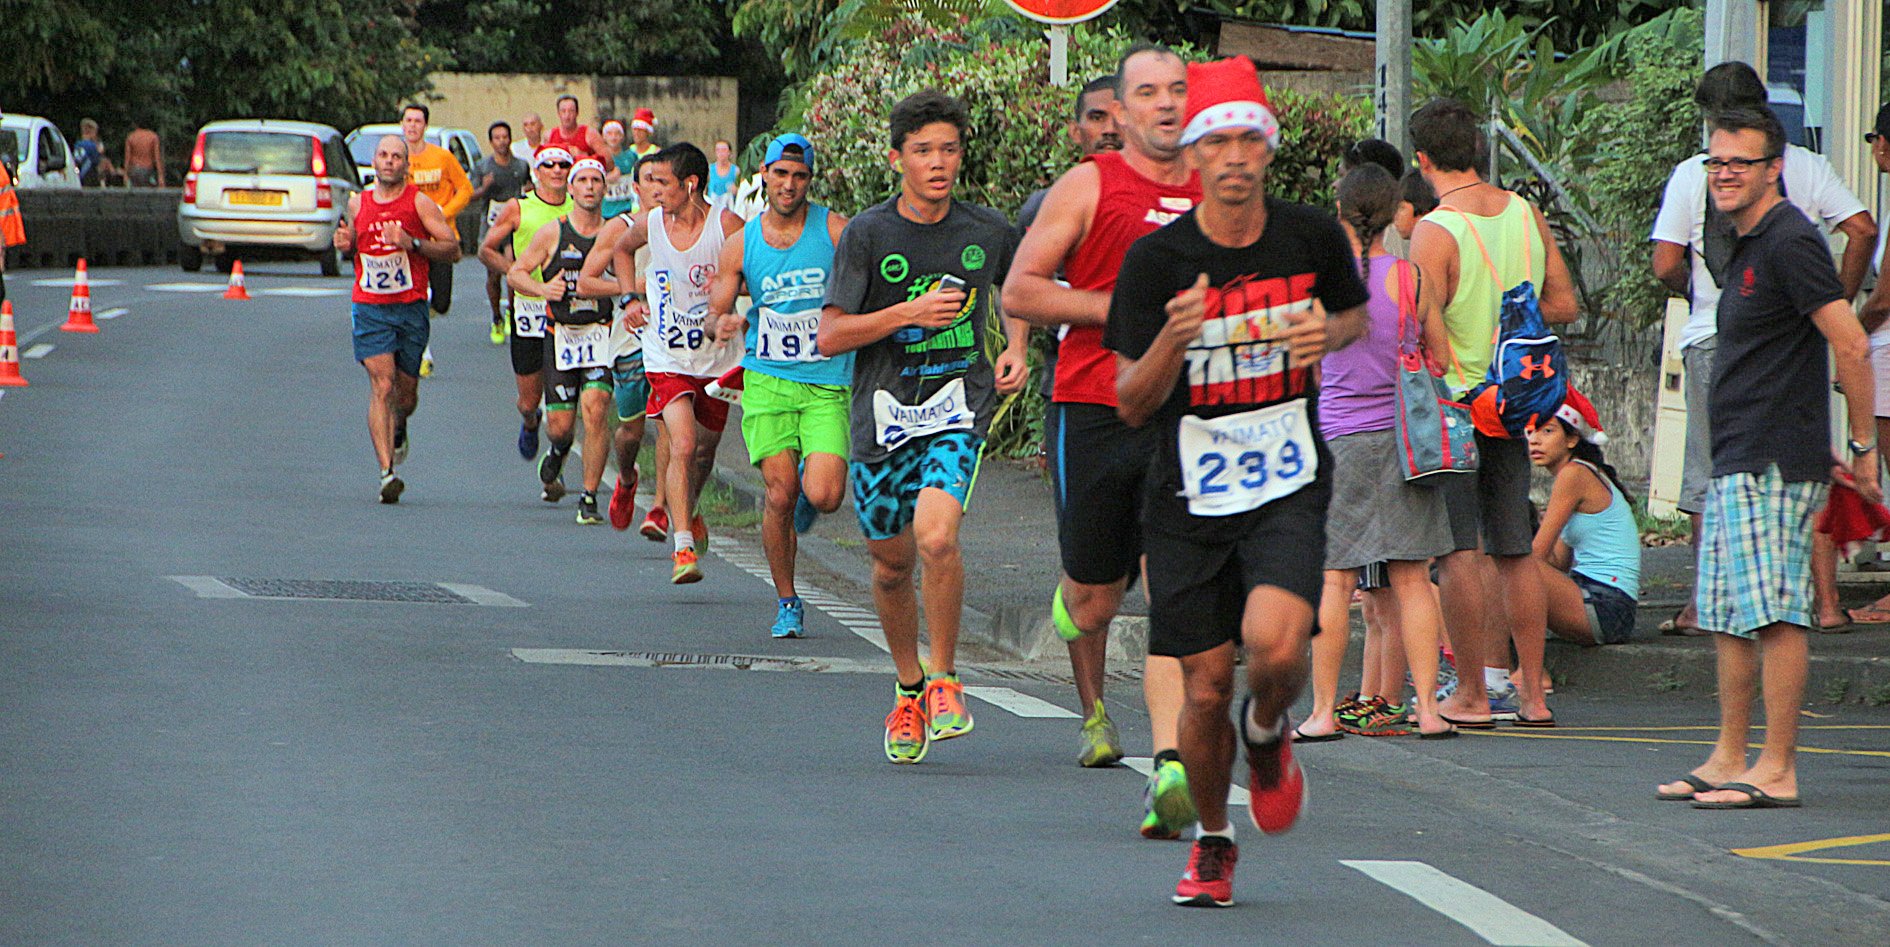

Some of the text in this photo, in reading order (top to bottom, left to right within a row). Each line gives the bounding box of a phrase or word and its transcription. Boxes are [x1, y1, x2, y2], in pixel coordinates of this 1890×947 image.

[366, 268, 407, 289] 124
[761, 268, 826, 292] AITO
[761, 284, 825, 304] SPORT
[1175, 271, 1316, 347] RIDE
[766, 316, 819, 332] VAIMATO
[561, 344, 595, 365] 411
[888, 396, 955, 423] VAIMATO
[1208, 411, 1298, 445] VAIMATO
